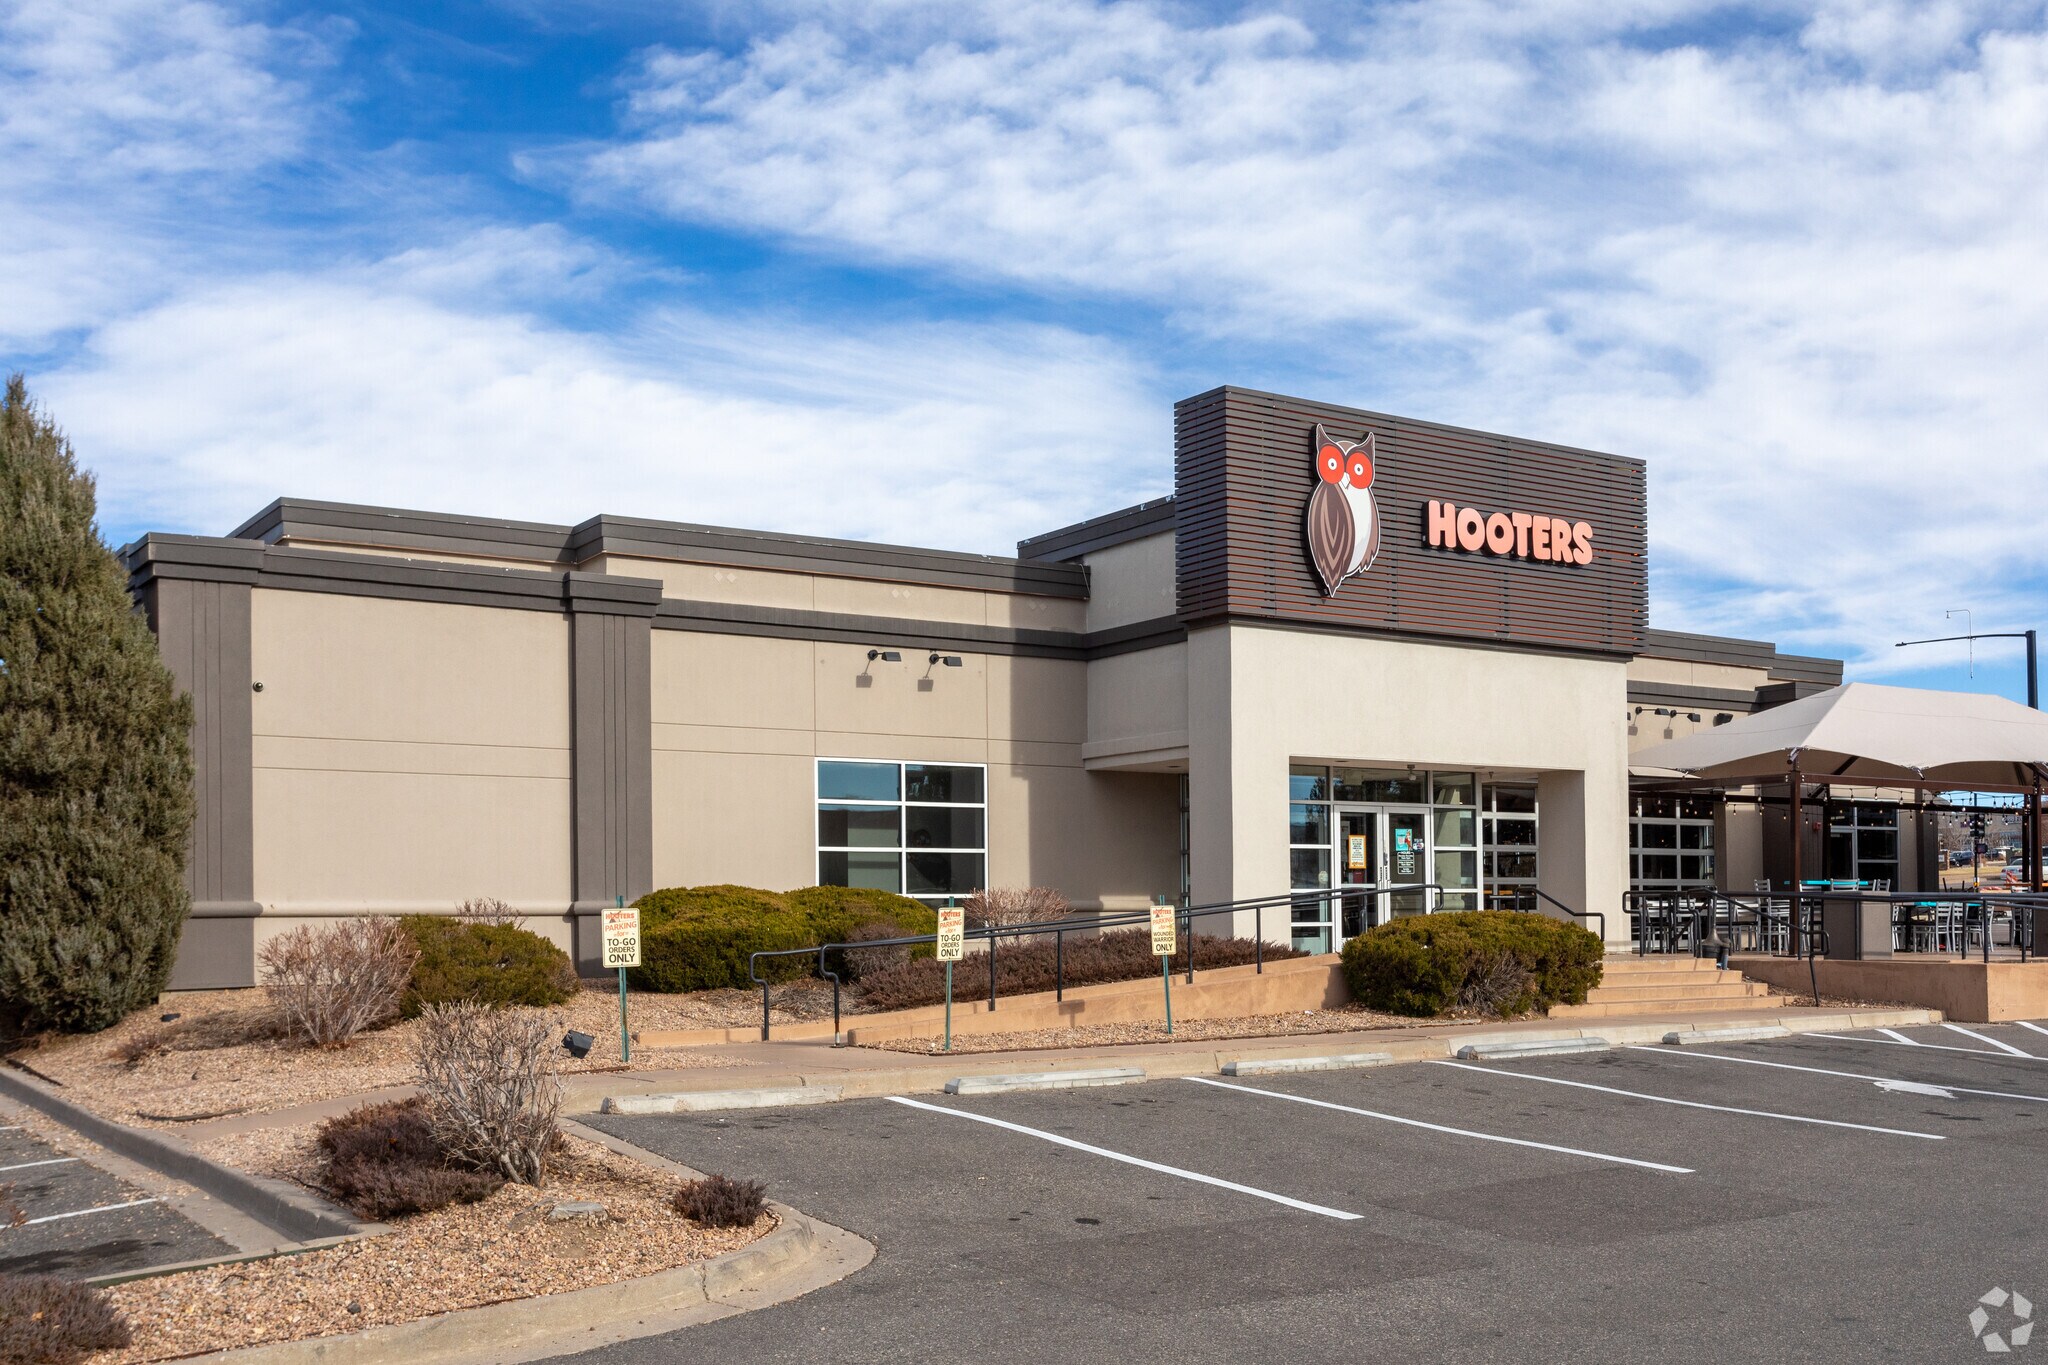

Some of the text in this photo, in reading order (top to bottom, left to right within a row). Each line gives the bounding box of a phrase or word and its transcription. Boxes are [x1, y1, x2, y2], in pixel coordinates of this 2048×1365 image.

[1428, 499, 1594, 565] HOOTERS
[605, 922, 637, 932] PARKING
[940, 920, 962, 928] PARKING
[607, 938, 636, 946] TO-GO
[1156, 944, 1172, 952] ONLY
[940, 949, 960, 957] ONLY
[609, 954, 635, 962] ONLY
